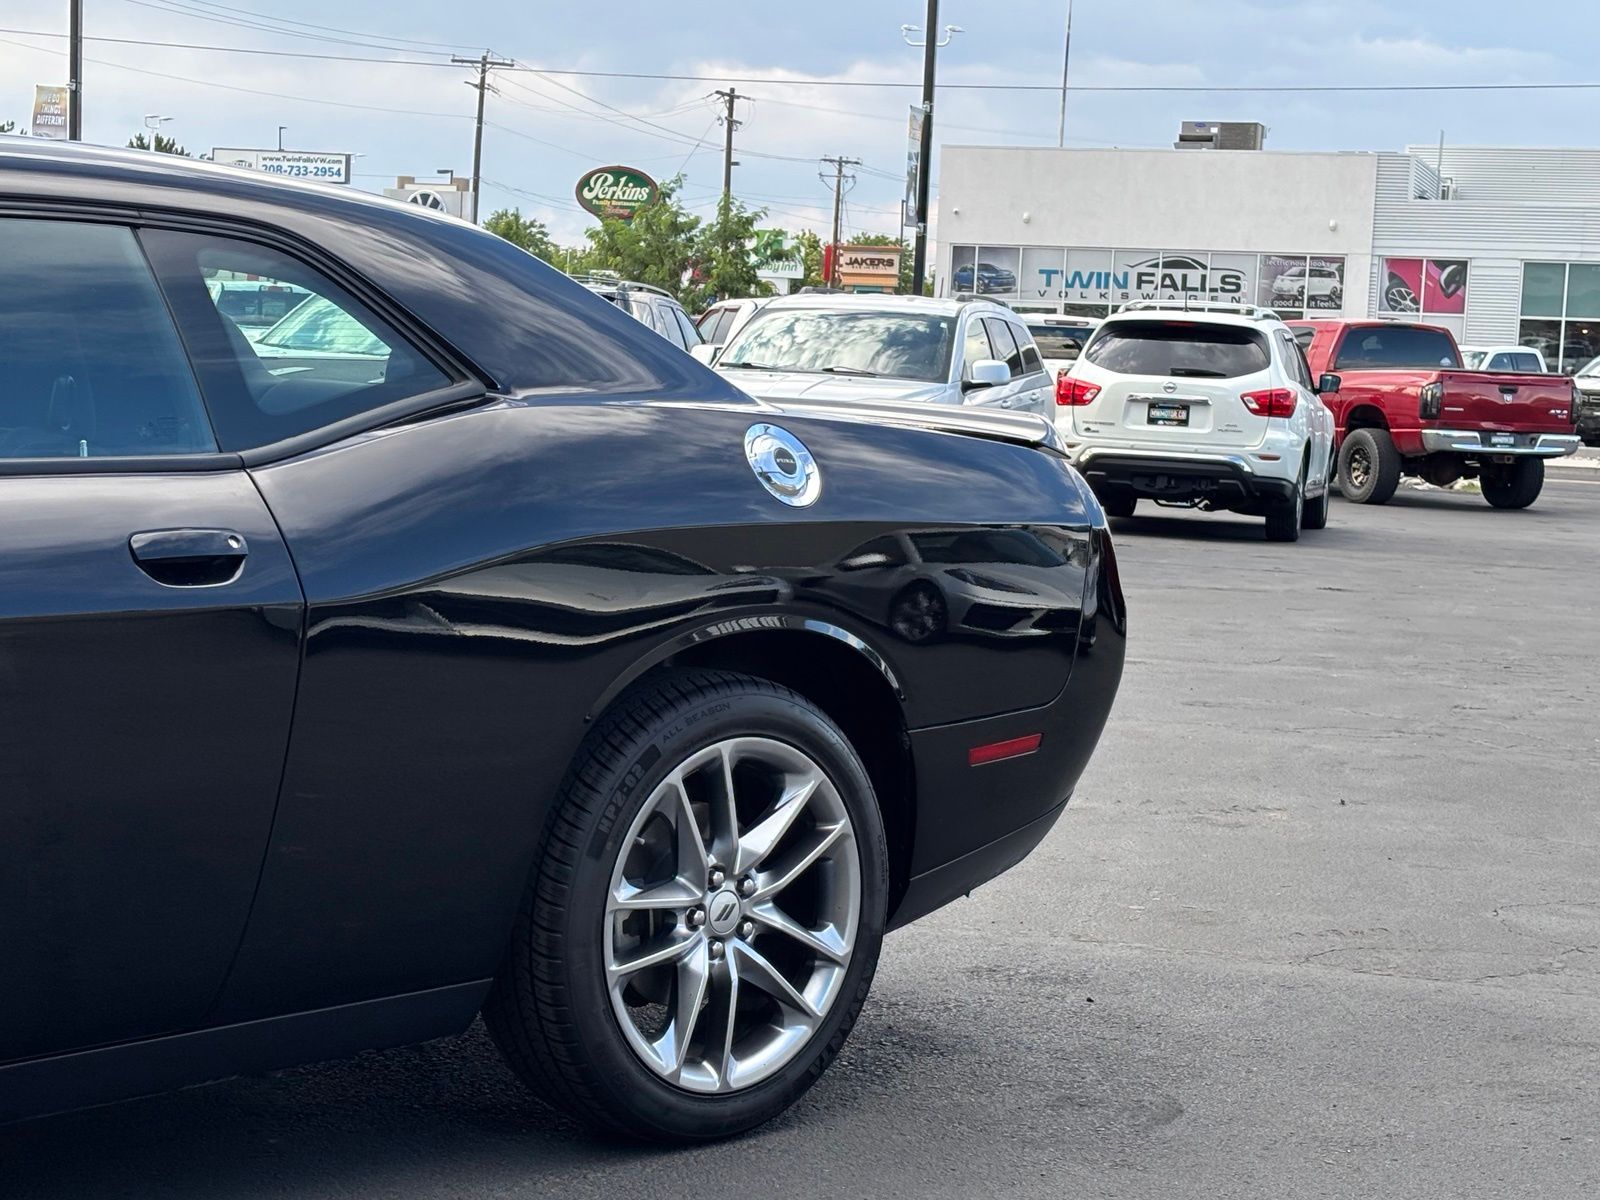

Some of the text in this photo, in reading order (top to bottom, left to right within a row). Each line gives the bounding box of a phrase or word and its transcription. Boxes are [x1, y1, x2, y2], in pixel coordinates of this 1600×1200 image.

[36, 114, 65, 126] DIFFERENT
[261, 154, 343, 165] www.TwinFallsVW.com
[582, 172, 650, 201] Perkins
[845, 256, 894, 268] JAKERS
[1038, 269, 1242, 294] TWIN FALLS
[1038, 290, 1241, 305] VOLKSWAGEN
[1273, 299, 1293, 307] good
[662, 726, 683, 744] ALL
[598, 763, 647, 834] HPZ-02
